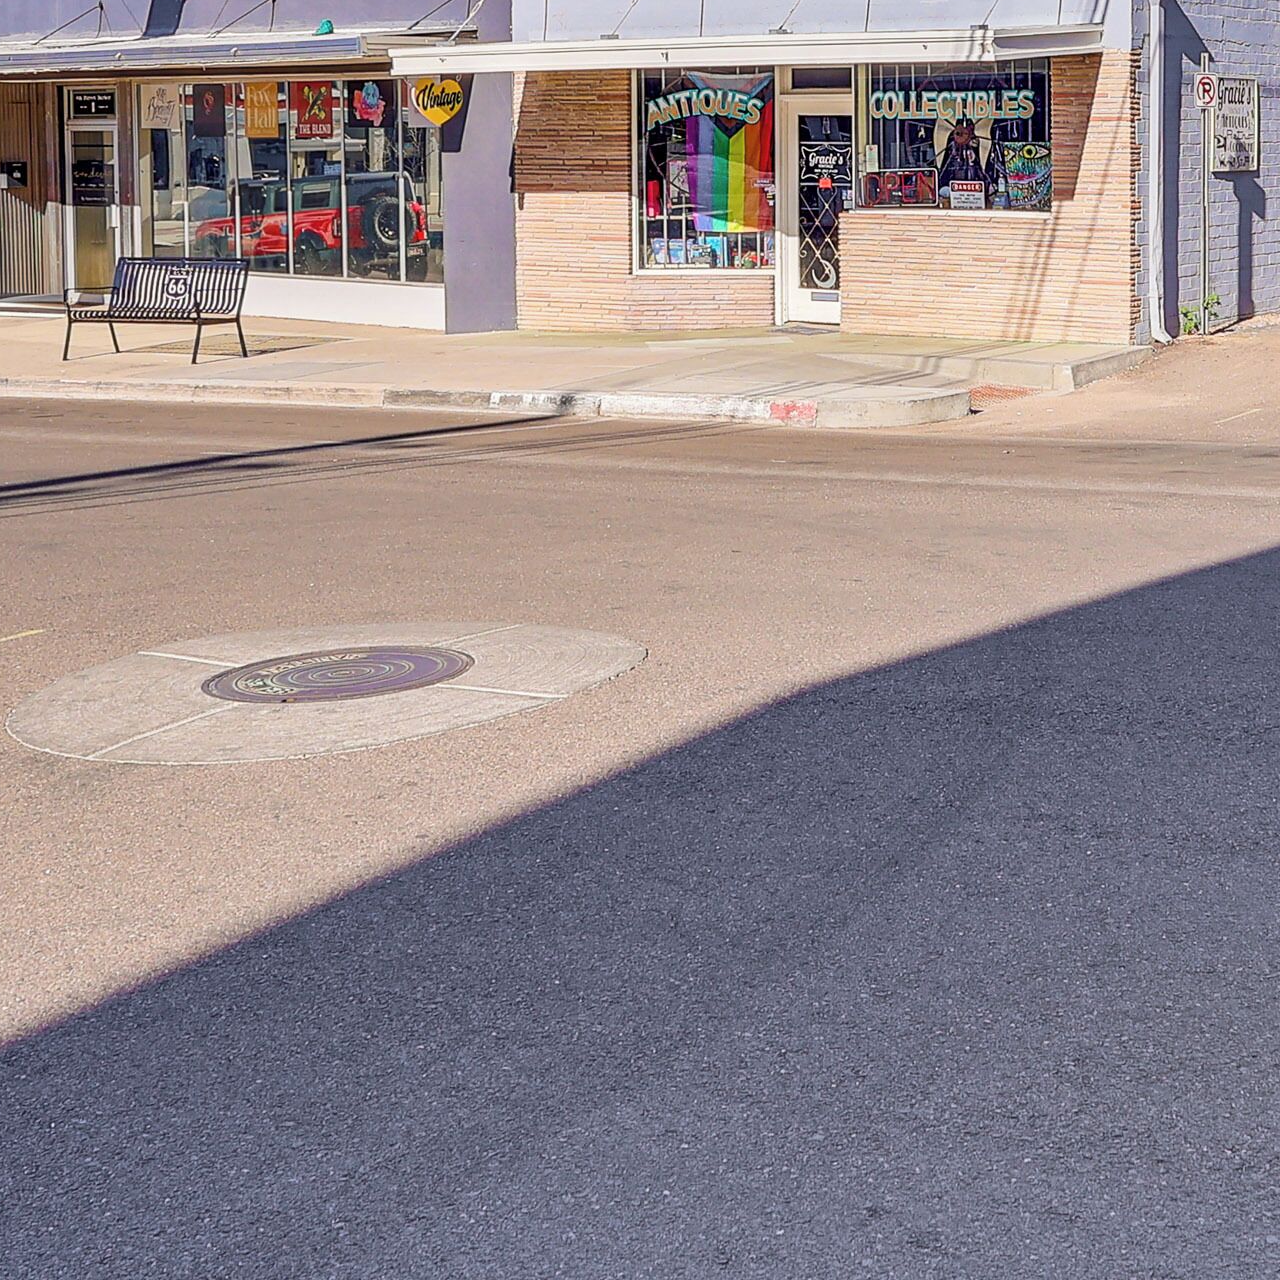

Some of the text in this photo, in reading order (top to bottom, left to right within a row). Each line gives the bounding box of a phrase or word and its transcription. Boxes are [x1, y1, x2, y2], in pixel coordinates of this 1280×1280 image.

[246, 82, 277, 107] Fox
[417, 83, 463, 112] Vintage
[870, 89, 1035, 120] COLLECTIBLES
[1217, 78, 1251, 111] Gracie's
[246, 107, 276, 128] Hall
[647, 88, 765, 131] ANTIQUES
[299, 123, 332, 135] THE BLEND
[809, 152, 844, 167] Gracie's
[866, 171, 935, 204] OPEN
[953, 183, 979, 191] DANGER
[169, 279, 185, 294] 66
